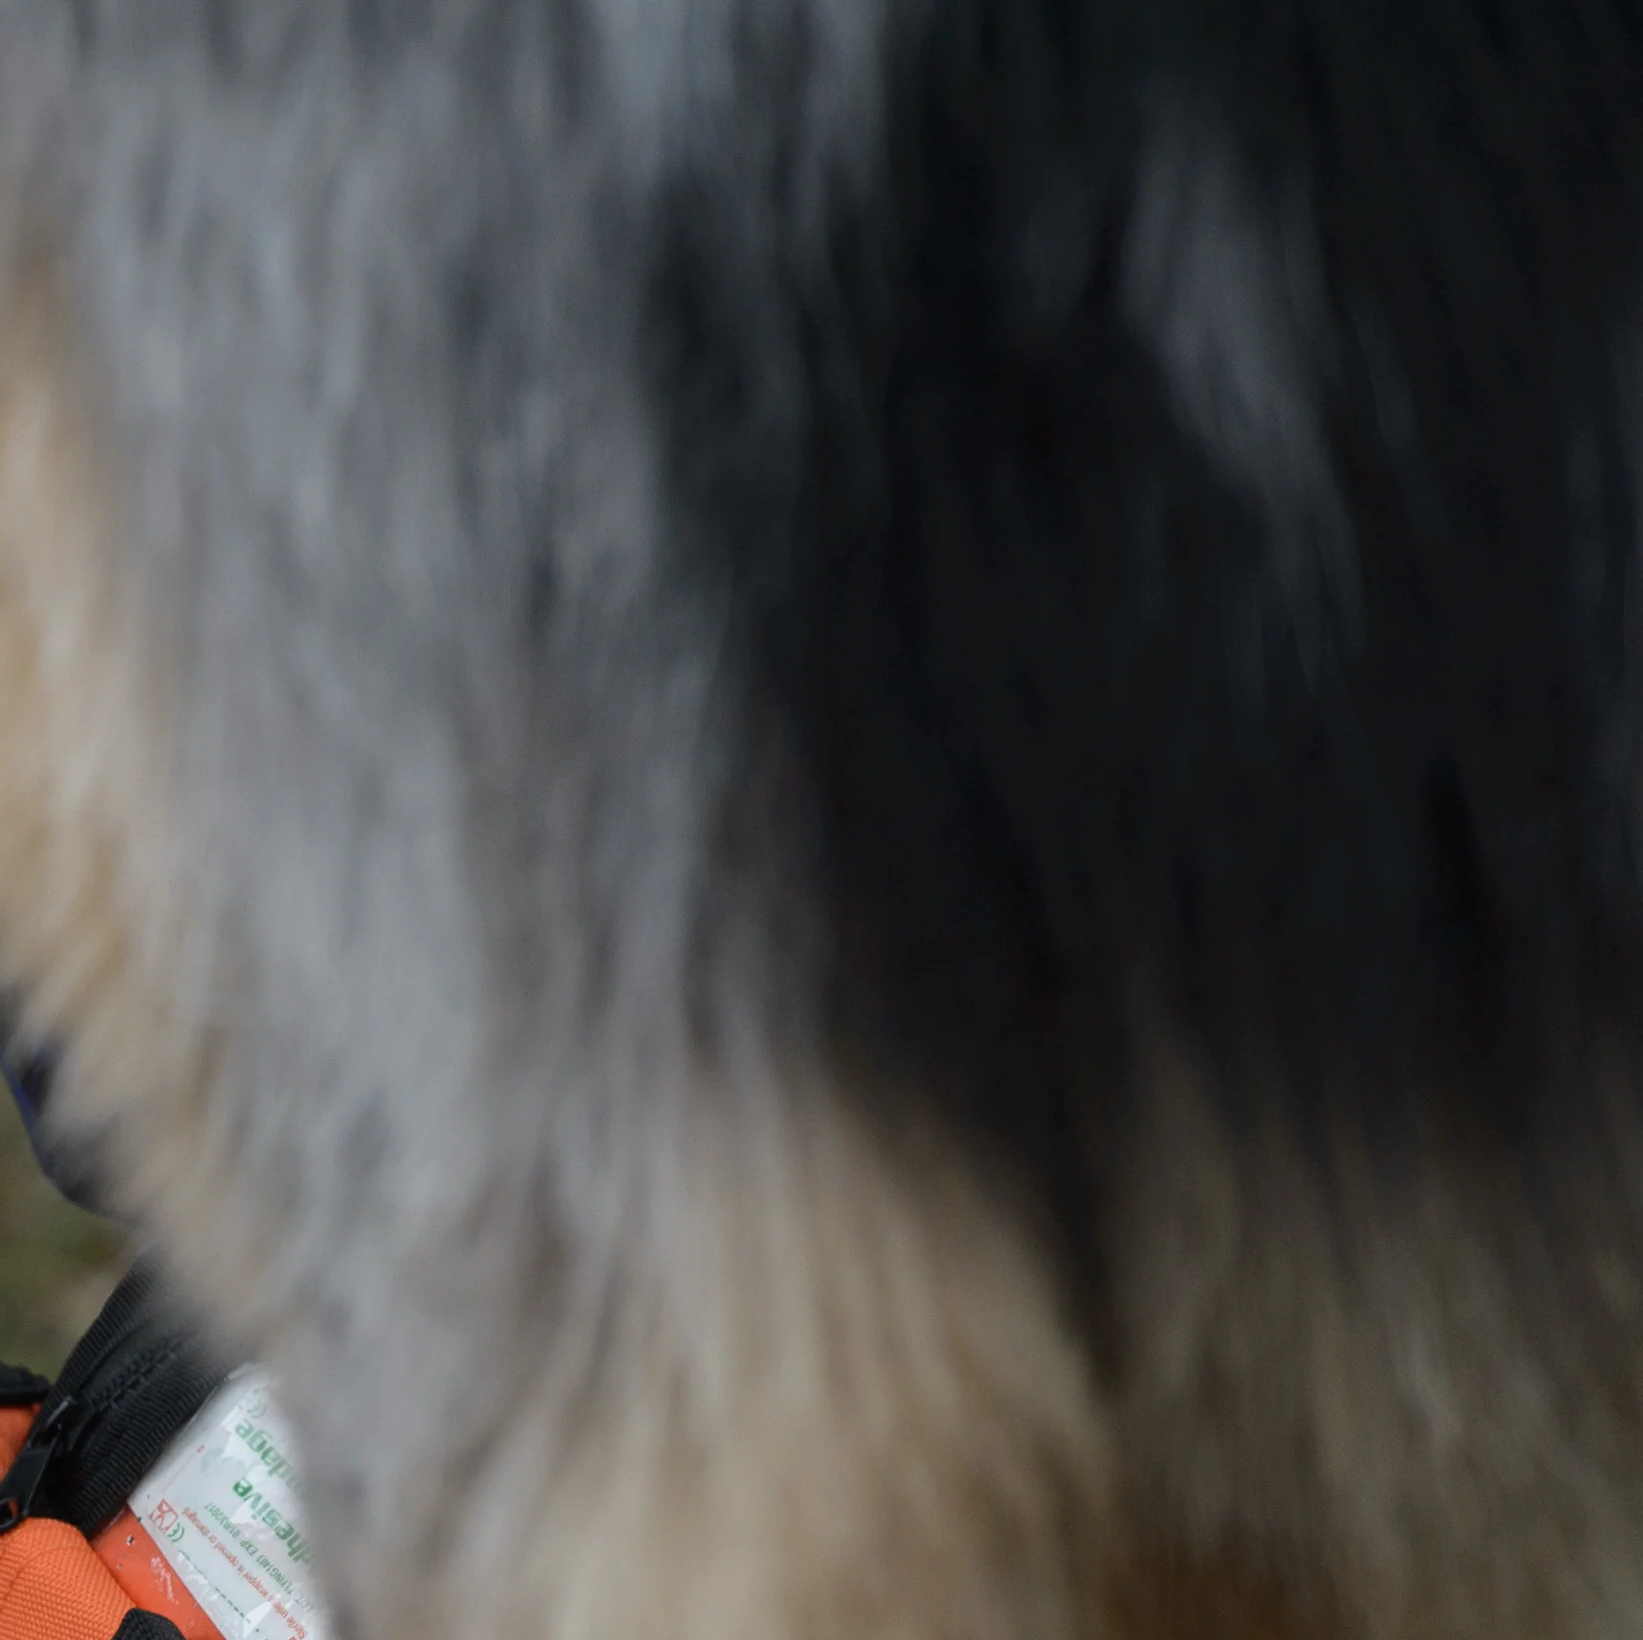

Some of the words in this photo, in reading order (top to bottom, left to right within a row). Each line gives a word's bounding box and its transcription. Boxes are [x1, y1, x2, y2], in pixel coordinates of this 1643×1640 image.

[233, 1476, 314, 1567] dhesive
[205, 1531, 219, 1545] or
[212, 1539, 241, 1569] opened
[233, 1563, 246, 1575] is
[240, 1569, 270, 1600] wrapper
[283, 1614, 307, 1640] Sterile
